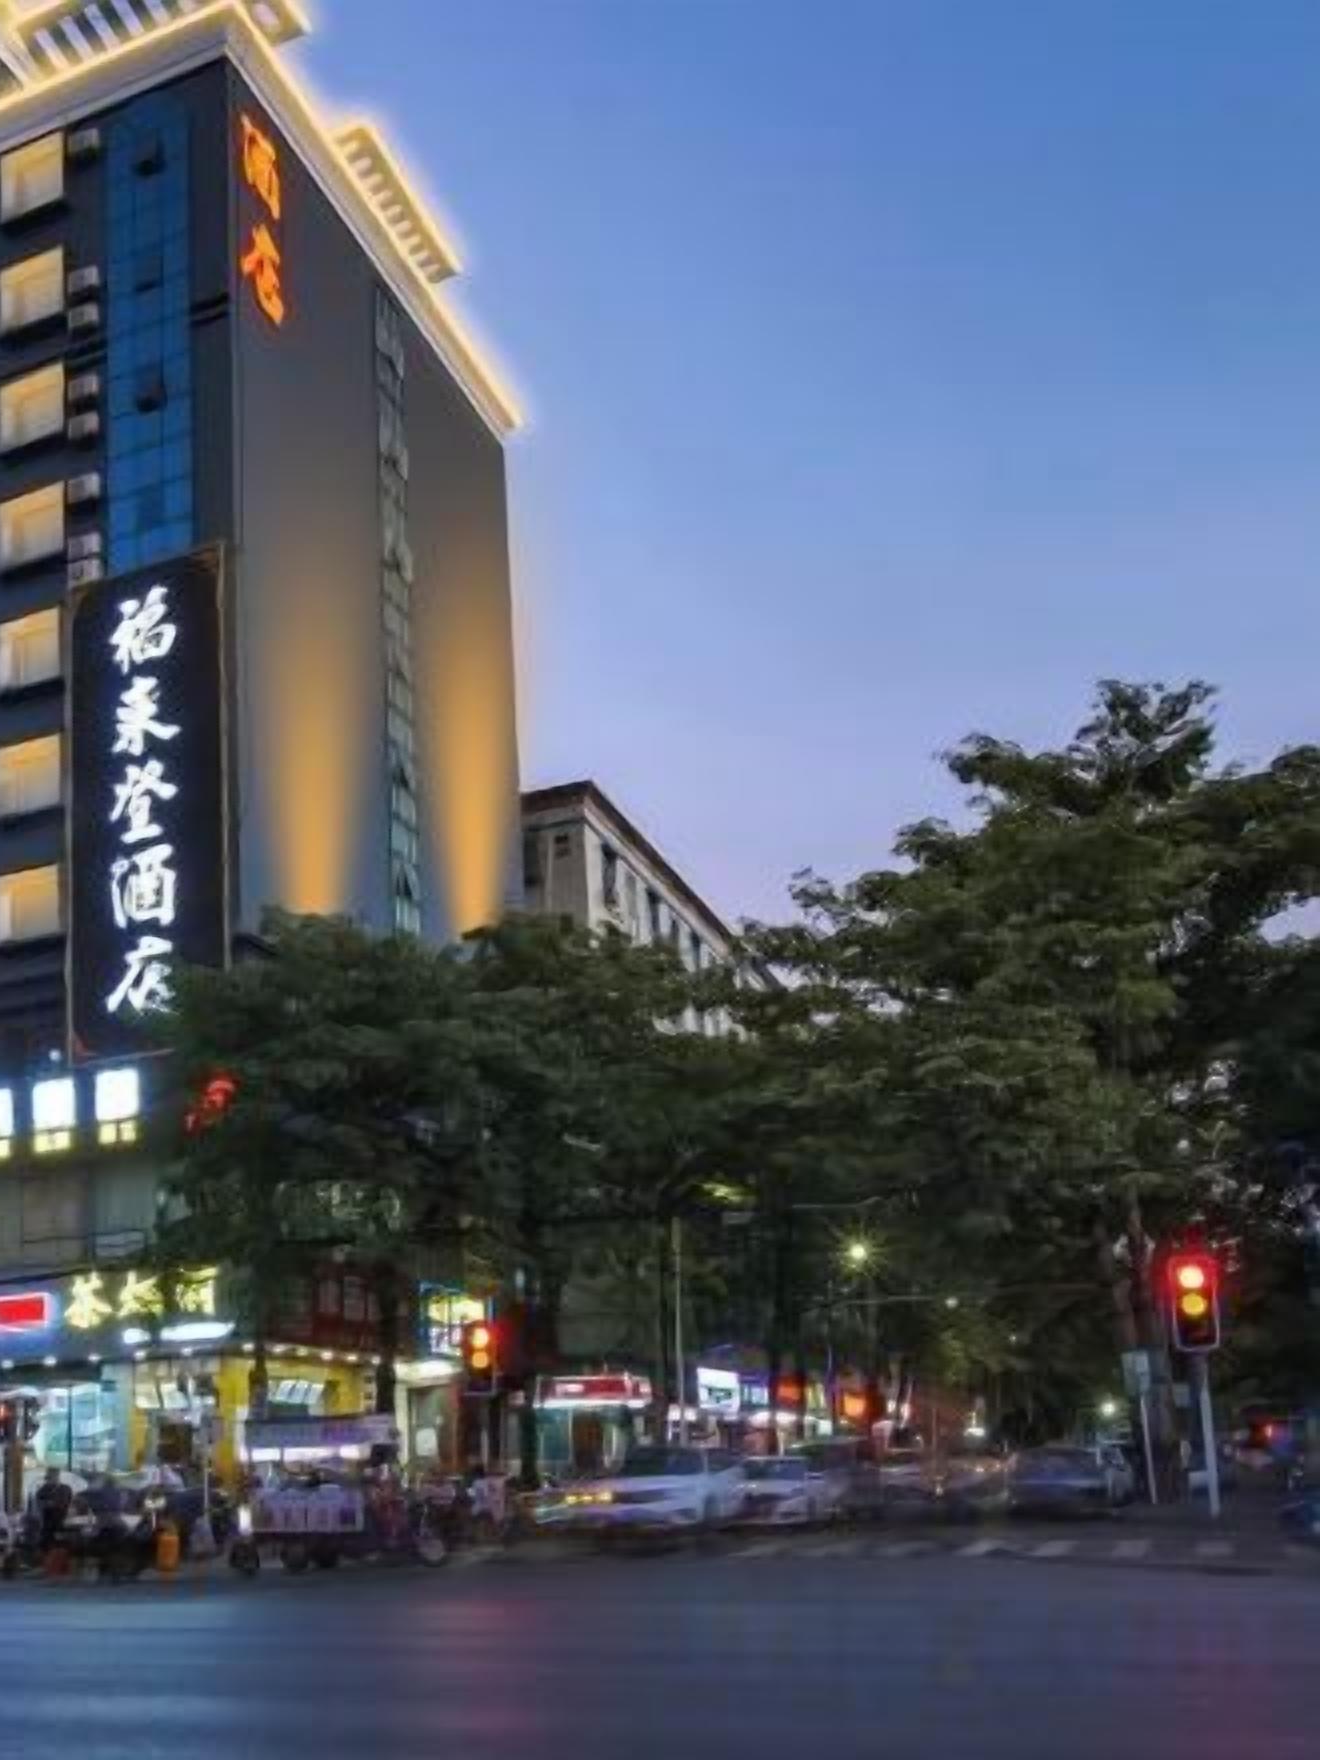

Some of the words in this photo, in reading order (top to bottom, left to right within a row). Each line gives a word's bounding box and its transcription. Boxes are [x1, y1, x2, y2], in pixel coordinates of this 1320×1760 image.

[106, 584, 182, 1016] 福来登酒店
